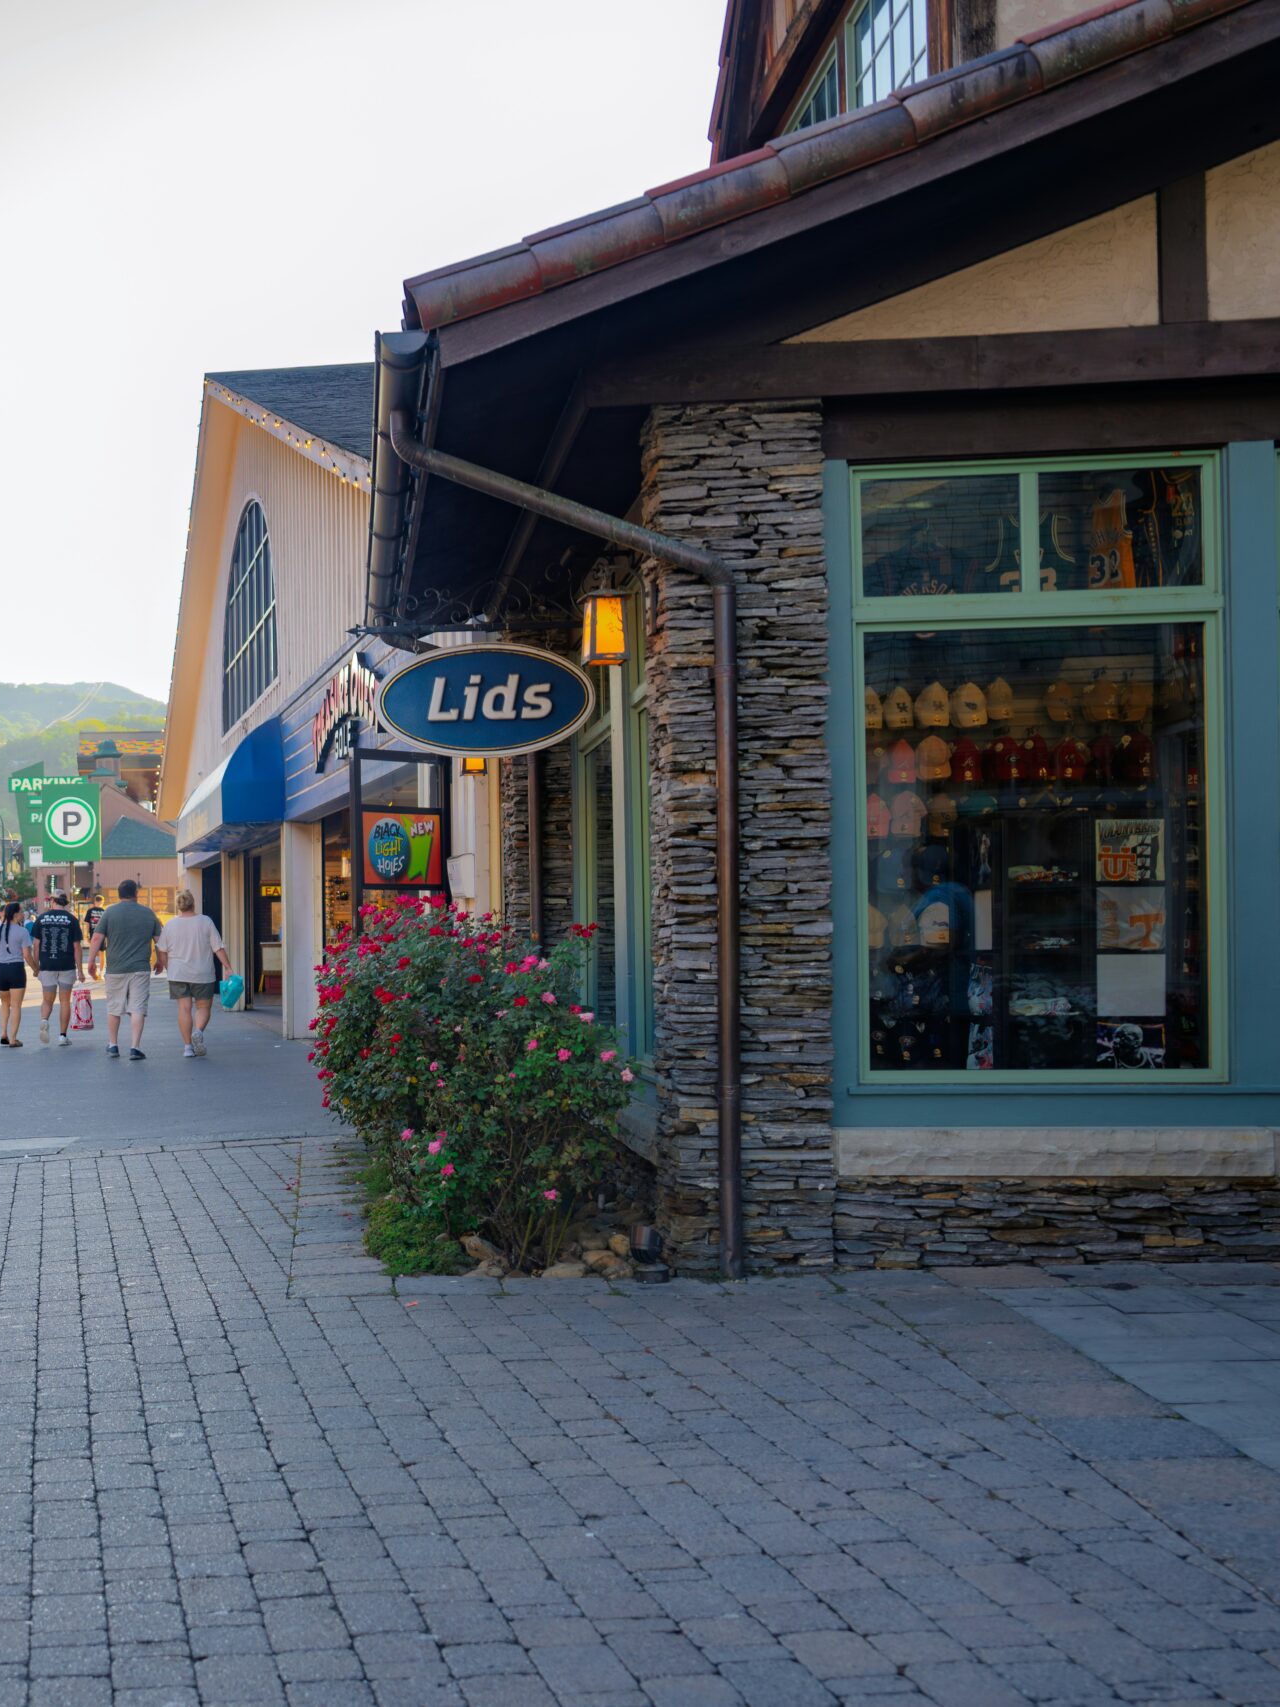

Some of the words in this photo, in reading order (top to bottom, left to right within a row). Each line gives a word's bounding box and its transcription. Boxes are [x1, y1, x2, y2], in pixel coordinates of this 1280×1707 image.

[350, 651, 379, 733] QUES
[427, 673, 553, 722] Lids
[373, 822, 404, 840] BLACK
[410, 820, 434, 838] NEW
[377, 855, 405, 876] HOLES
